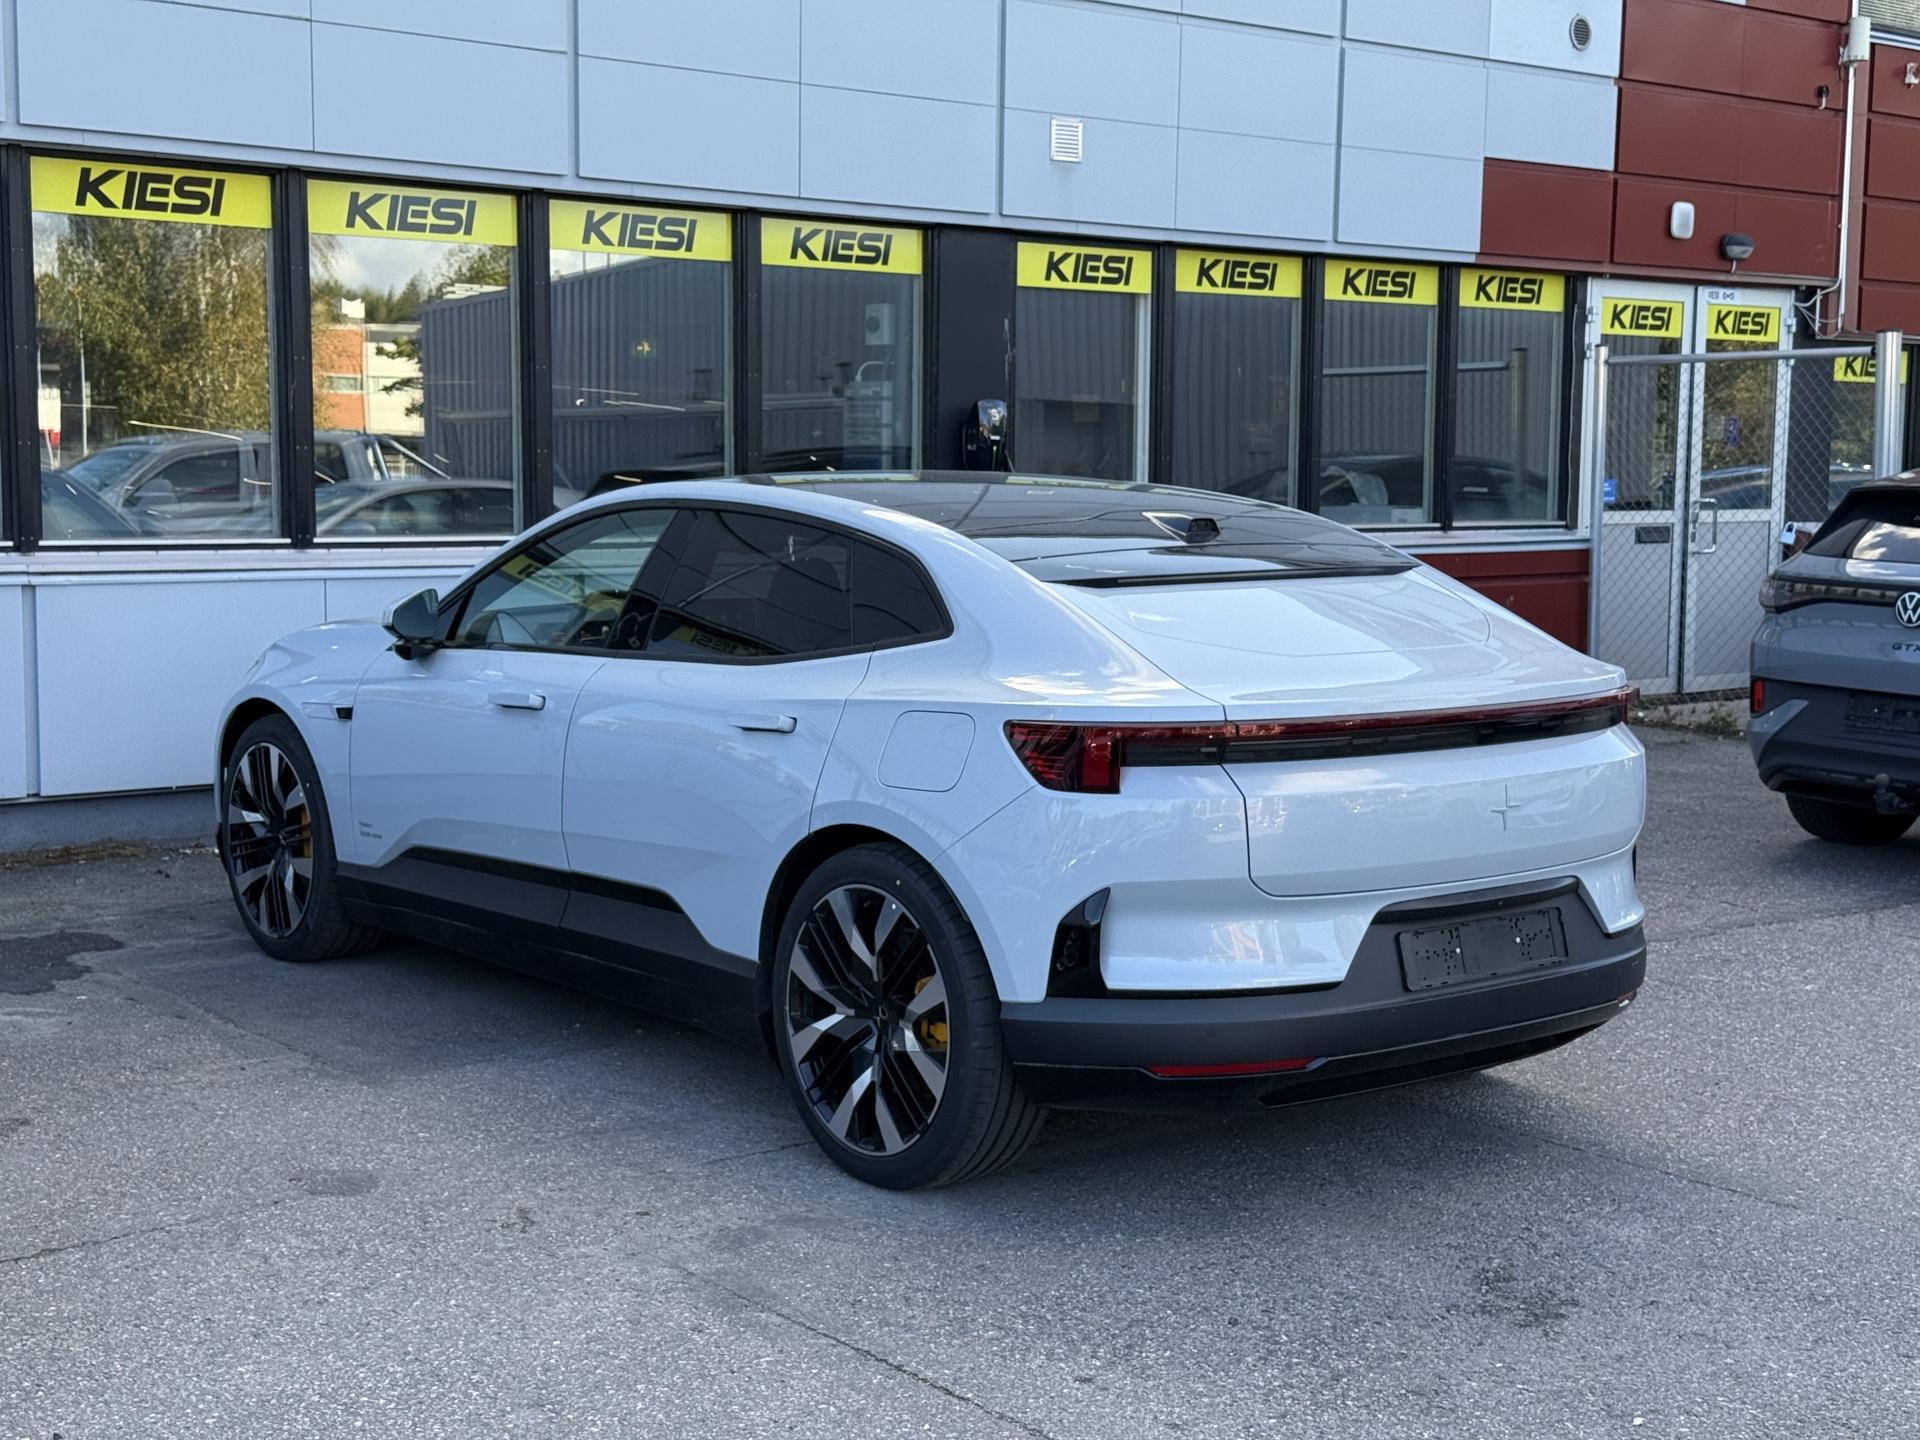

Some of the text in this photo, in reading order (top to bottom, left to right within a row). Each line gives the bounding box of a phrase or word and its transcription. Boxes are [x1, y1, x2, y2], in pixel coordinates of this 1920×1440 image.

[76, 167, 225, 216] KIESI
[346, 192, 477, 235] KIESI
[582, 210, 697, 252] KIESI
[790, 227, 892, 265] KIESI
[1045, 251, 1133, 285] KIESI
[1197, 258, 1278, 290] KIESI
[1343, 268, 1416, 298] KIESI
[1475, 274, 1544, 304] KIESI
[1610, 304, 1672, 331] KIESI
[1715, 310, 1770, 336] KIESI
[1843, 356, 1876, 377] KIE
